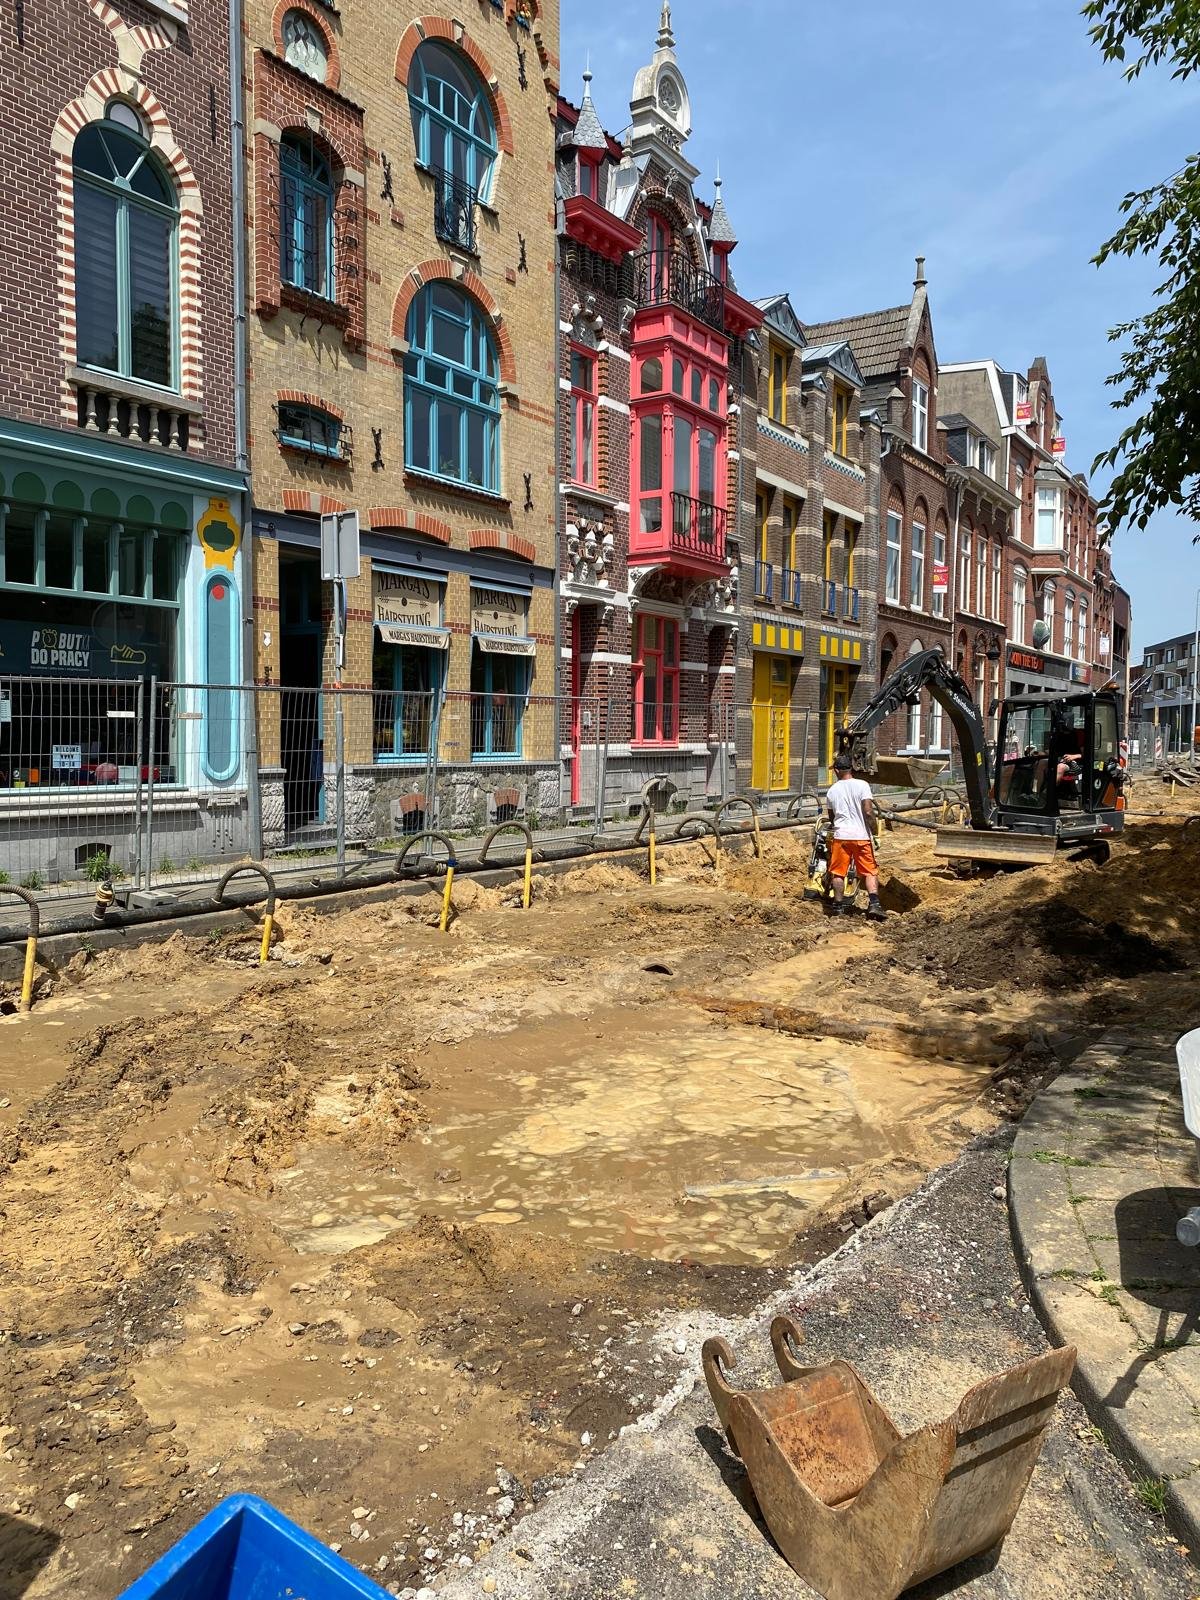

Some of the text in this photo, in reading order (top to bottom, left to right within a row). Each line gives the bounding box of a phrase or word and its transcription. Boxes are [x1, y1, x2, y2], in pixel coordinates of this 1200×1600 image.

[377, 604, 431, 627] HAIRSTYLING
[474, 618, 518, 637] HAIRSTYLING
[410, 632, 442, 645] HAIRSTYLING
[31, 648, 90, 667] DO PRACY
